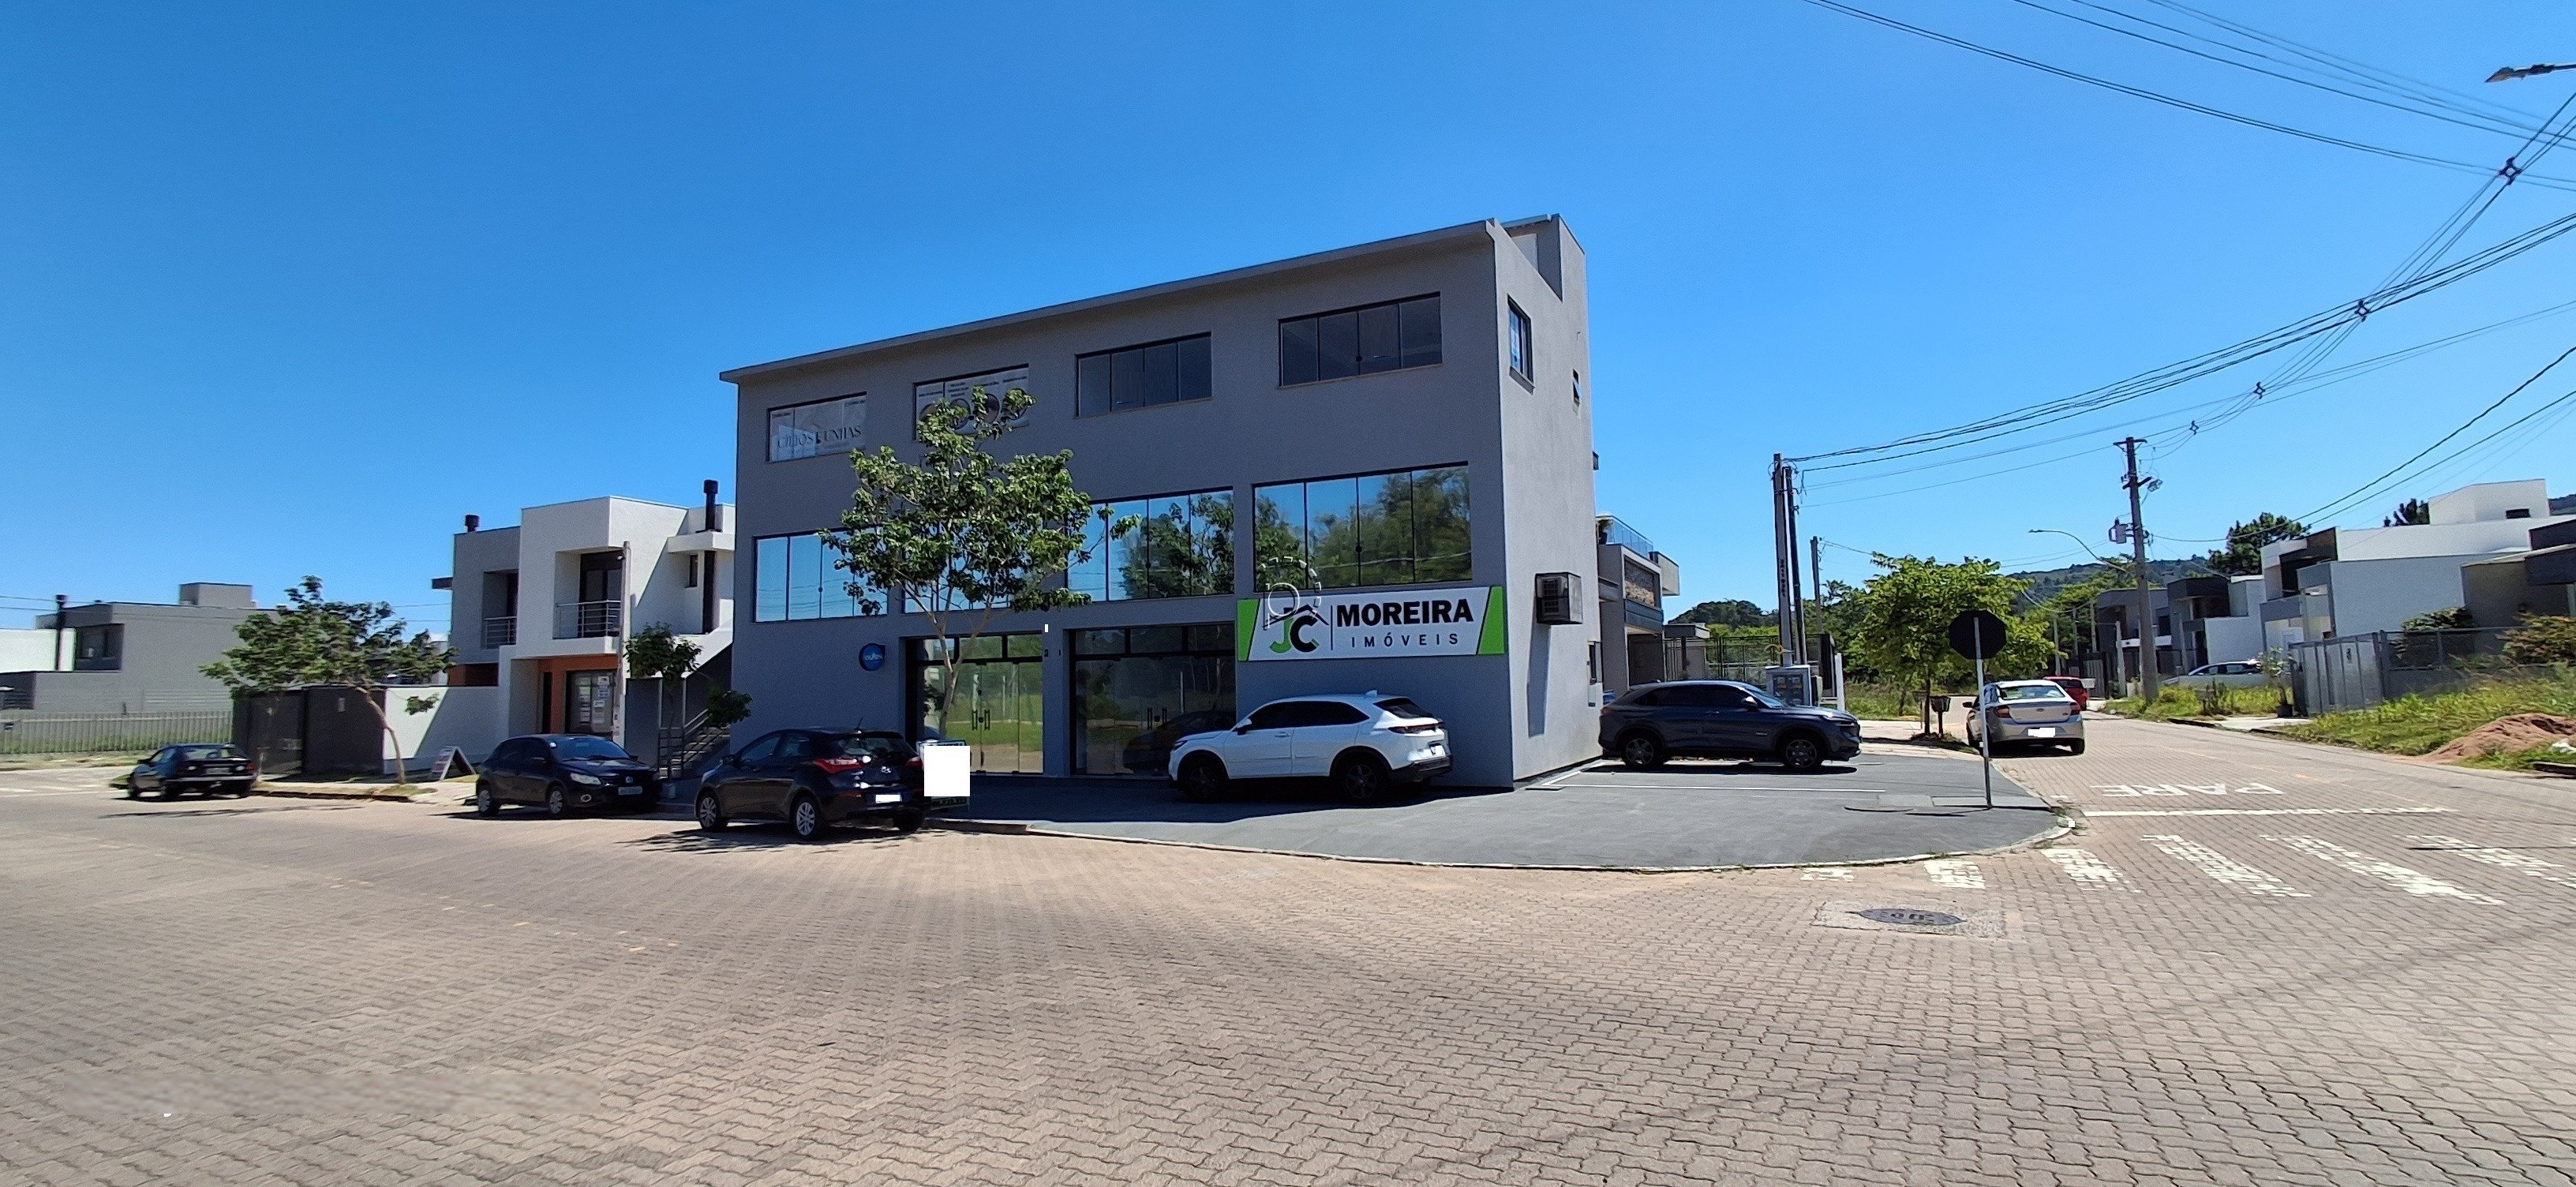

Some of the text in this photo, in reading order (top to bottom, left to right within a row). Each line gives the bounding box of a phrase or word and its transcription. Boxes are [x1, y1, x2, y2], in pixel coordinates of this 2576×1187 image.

[1336, 598, 1473, 627] MOREIRA
[1351, 632, 1458, 648] IMÓVEIS
[2090, 782, 2286, 797] PARE
